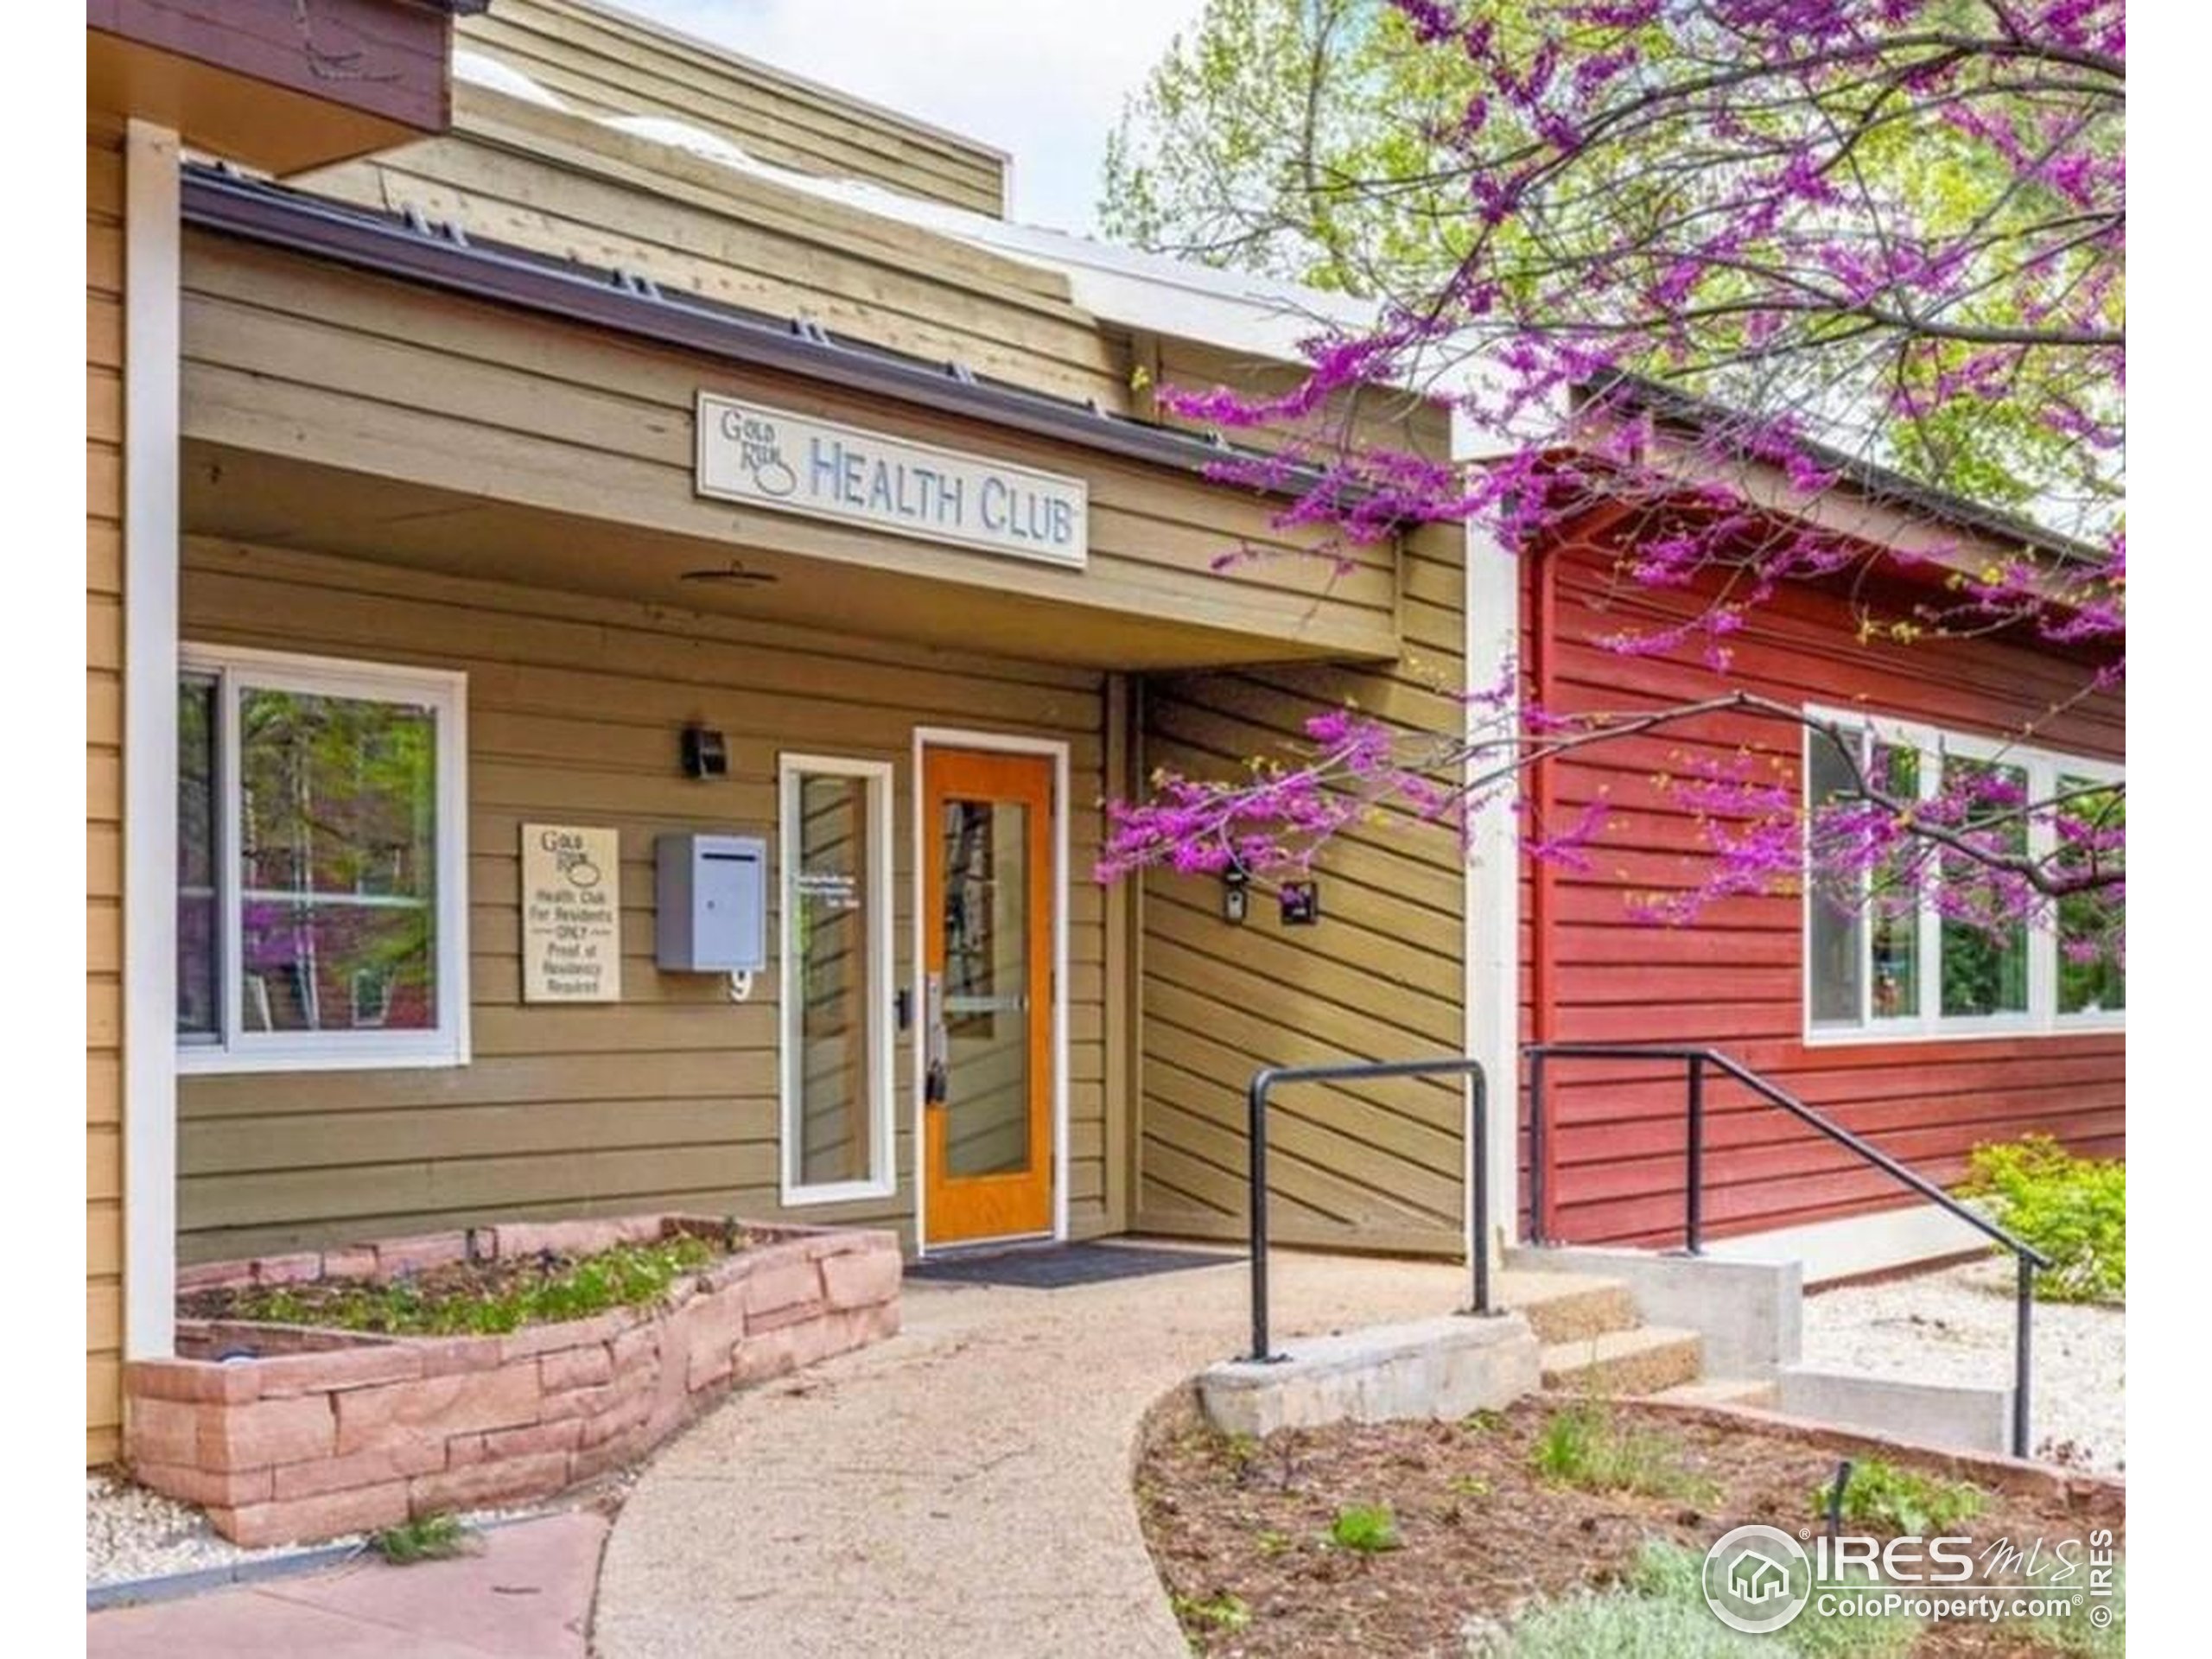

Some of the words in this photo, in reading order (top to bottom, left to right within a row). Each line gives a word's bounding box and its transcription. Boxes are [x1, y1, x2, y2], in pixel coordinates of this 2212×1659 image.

[721, 409, 775, 442] GOLD
[810, 438, 963, 524] HEALTH
[980, 477, 1073, 543] CLUB
[729, 970, 753, 1002] 9
